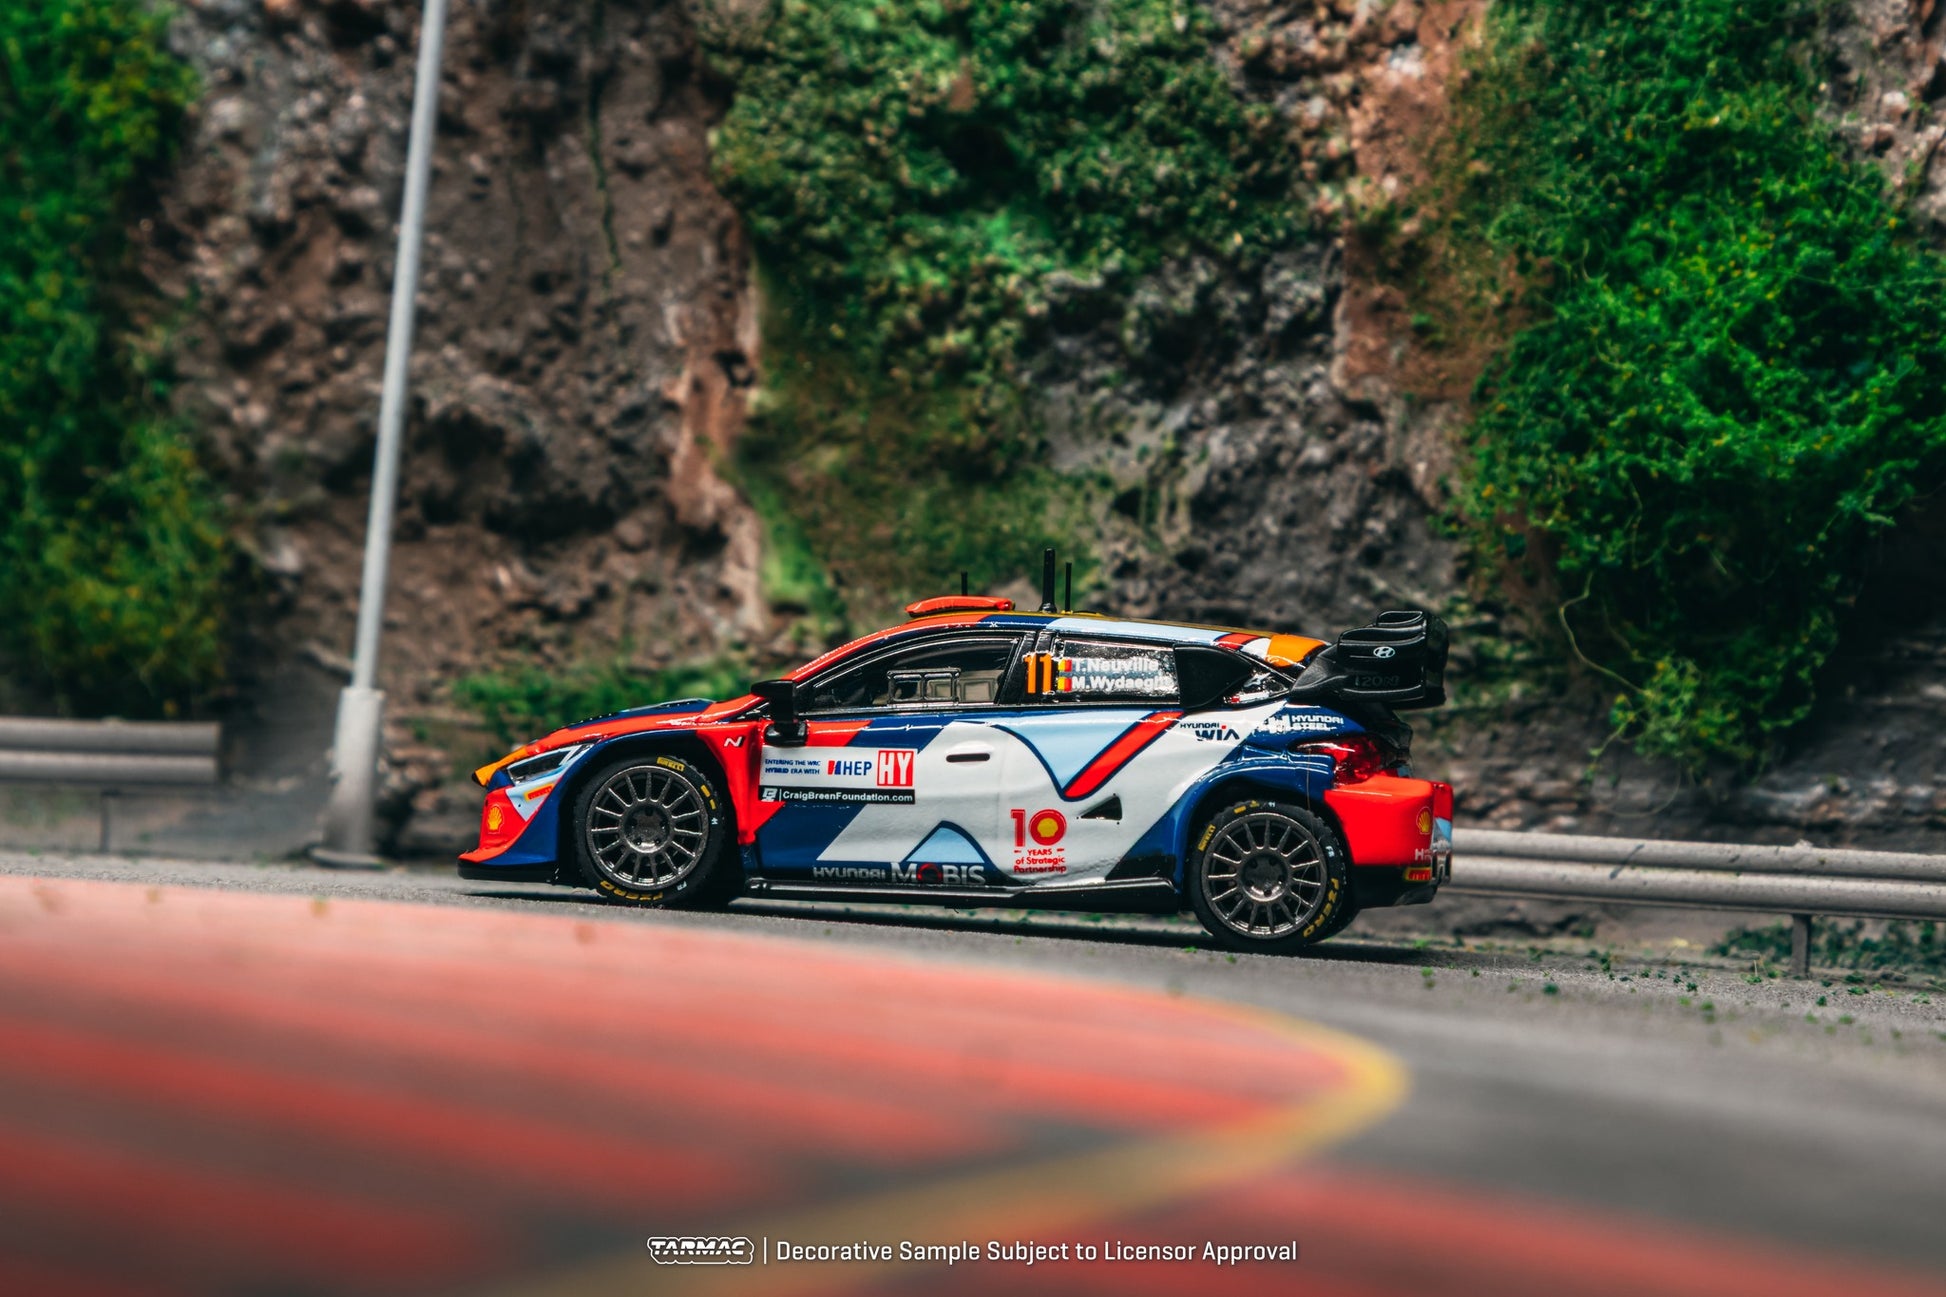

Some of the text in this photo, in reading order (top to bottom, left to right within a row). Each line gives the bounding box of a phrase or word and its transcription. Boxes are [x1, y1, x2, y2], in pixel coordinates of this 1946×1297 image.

[1024, 652, 1052, 694] 11
[1291, 715, 1344, 725] HYUNDAI
[1195, 725, 1240, 742] WIA
[843, 761, 872, 776] HEP
[878, 752, 912, 785] HY
[782, 790, 913, 802] CraigBreenFoundation.com
[1015, 856, 1065, 866] of Strategic
[813, 863, 986, 885] HYUNDAI MOBIS
[1014, 865, 1067, 874] Partnership
